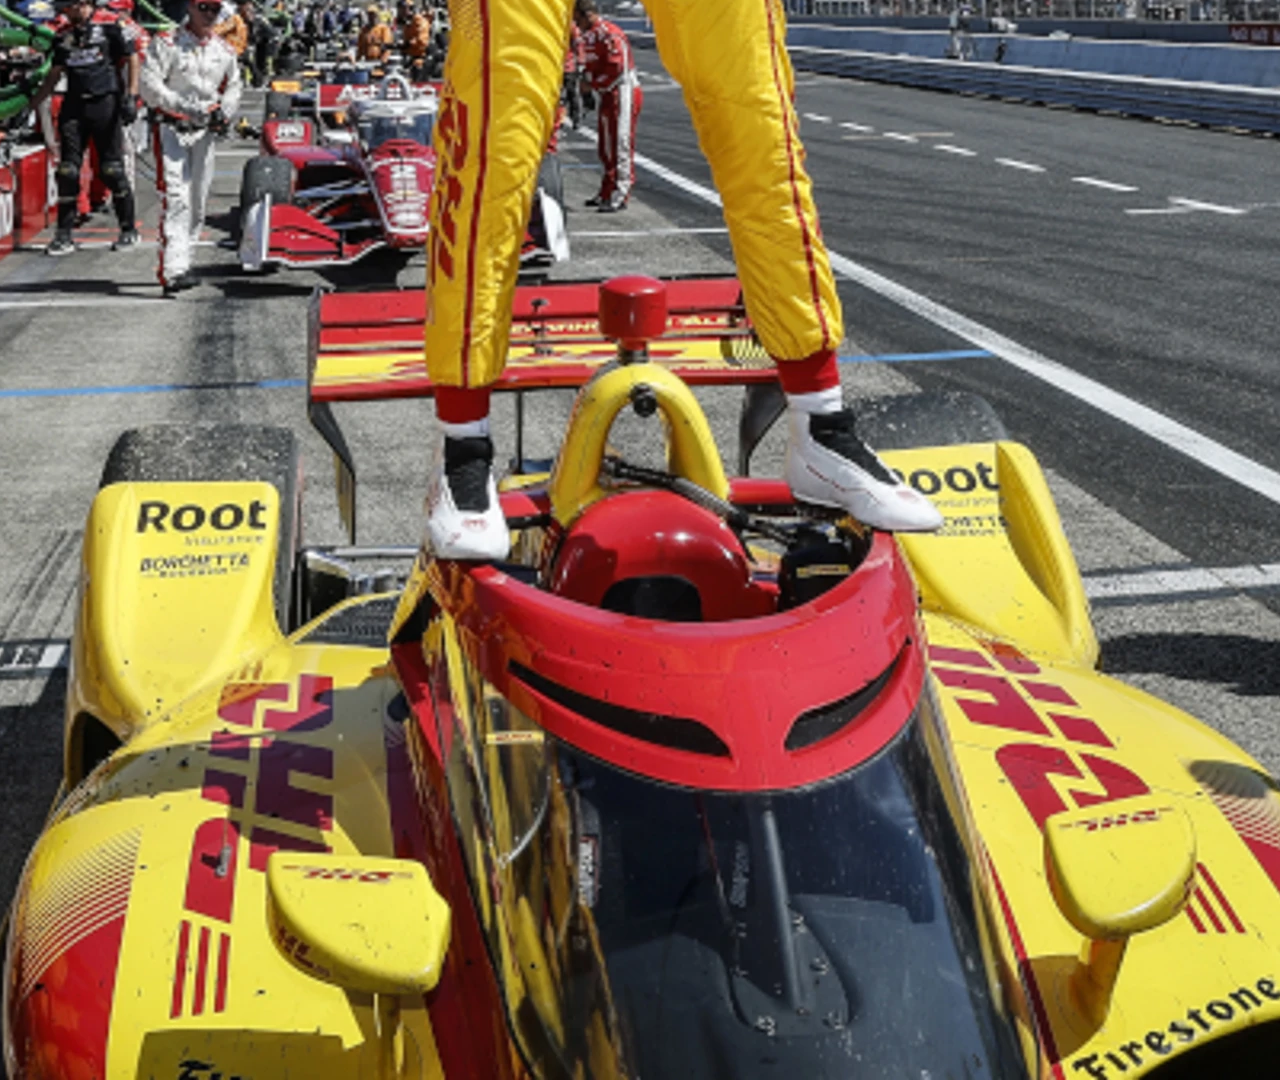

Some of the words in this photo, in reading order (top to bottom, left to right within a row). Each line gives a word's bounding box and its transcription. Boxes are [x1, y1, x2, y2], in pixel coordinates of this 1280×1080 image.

[891, 461, 1000, 495] oot
[136, 499, 267, 534] Root
[139, 552, 251, 573] BORCHETTA
